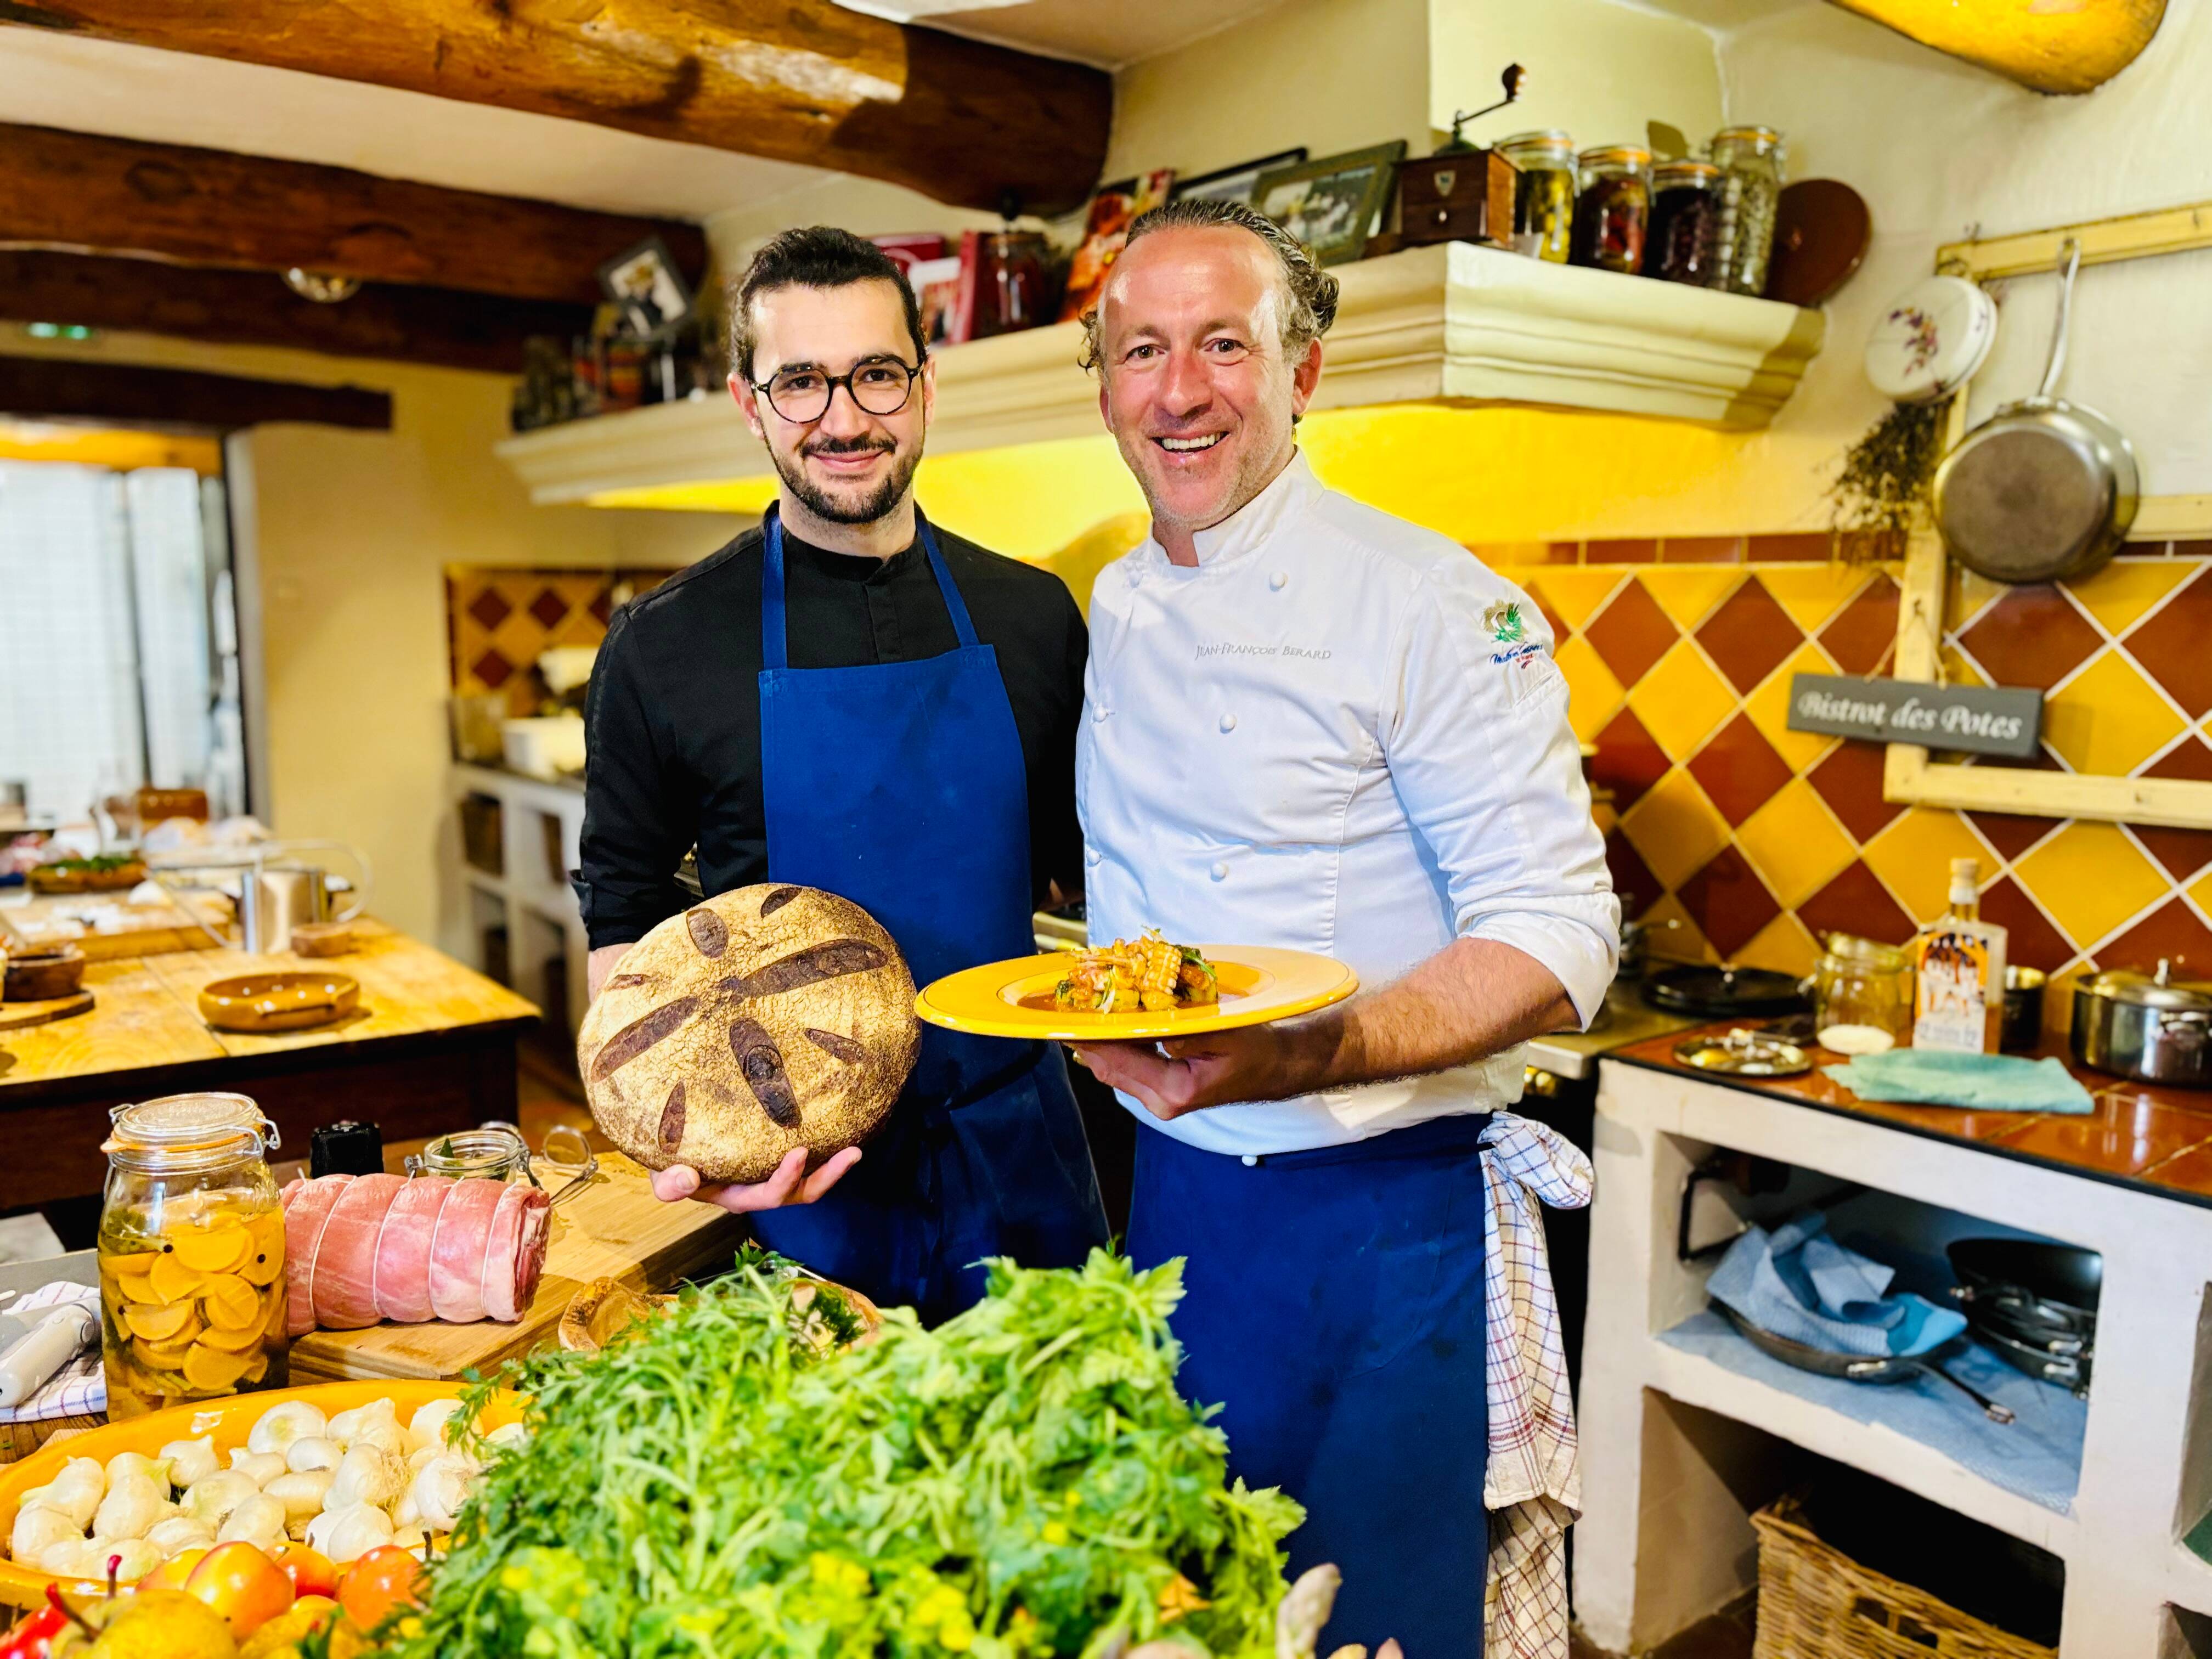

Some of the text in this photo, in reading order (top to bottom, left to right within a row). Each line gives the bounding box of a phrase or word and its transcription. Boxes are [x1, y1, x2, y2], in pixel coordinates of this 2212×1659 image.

[1797, 691, 2023, 740] Bistrot des Potes
